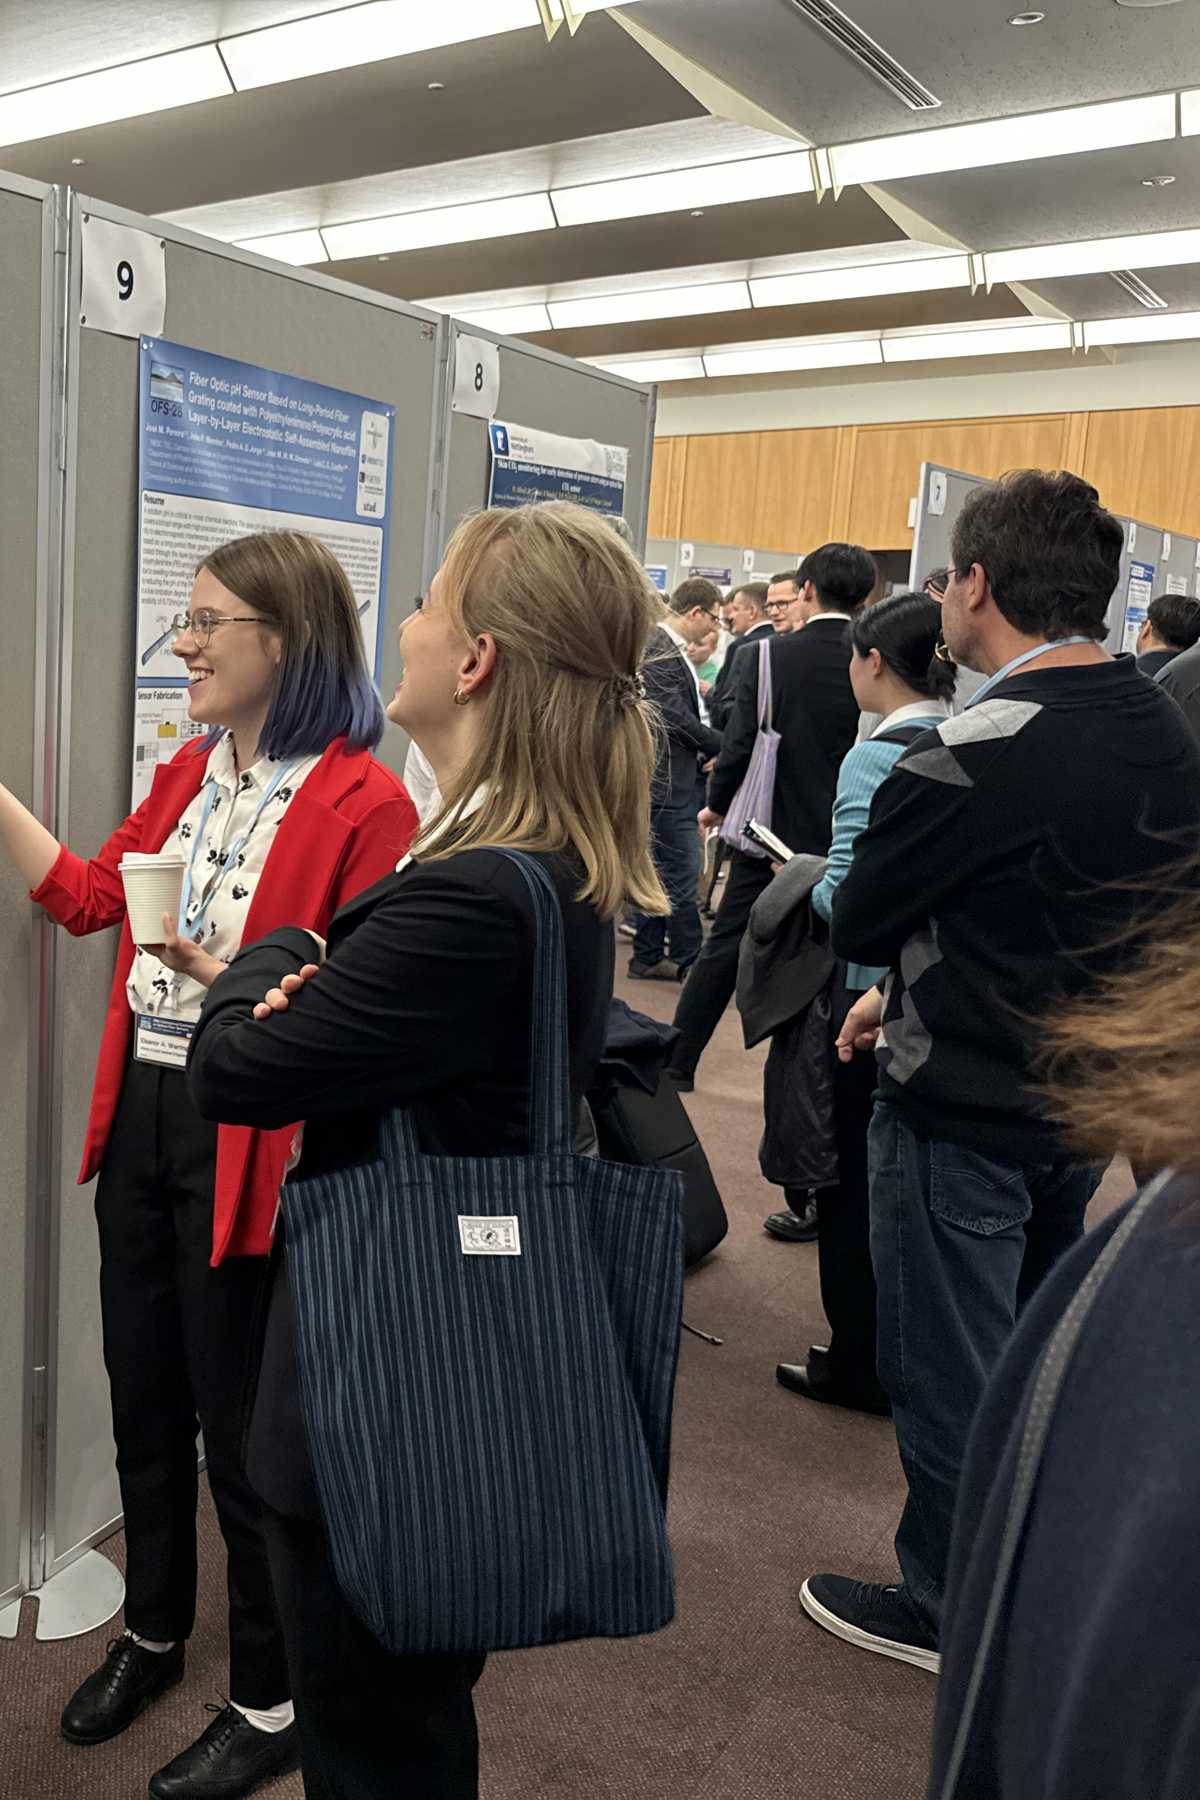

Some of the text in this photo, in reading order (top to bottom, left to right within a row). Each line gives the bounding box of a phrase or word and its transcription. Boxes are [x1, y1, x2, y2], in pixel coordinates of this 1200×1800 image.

[117, 260, 133, 301] 9
[189, 372, 209, 388] Fiber
[210, 376, 230, 393] Optic
[230, 383, 241, 397] pH
[242, 385, 267, 402] Sensor
[474, 362, 483, 391] 8
[188, 391, 215, 411] Grating
